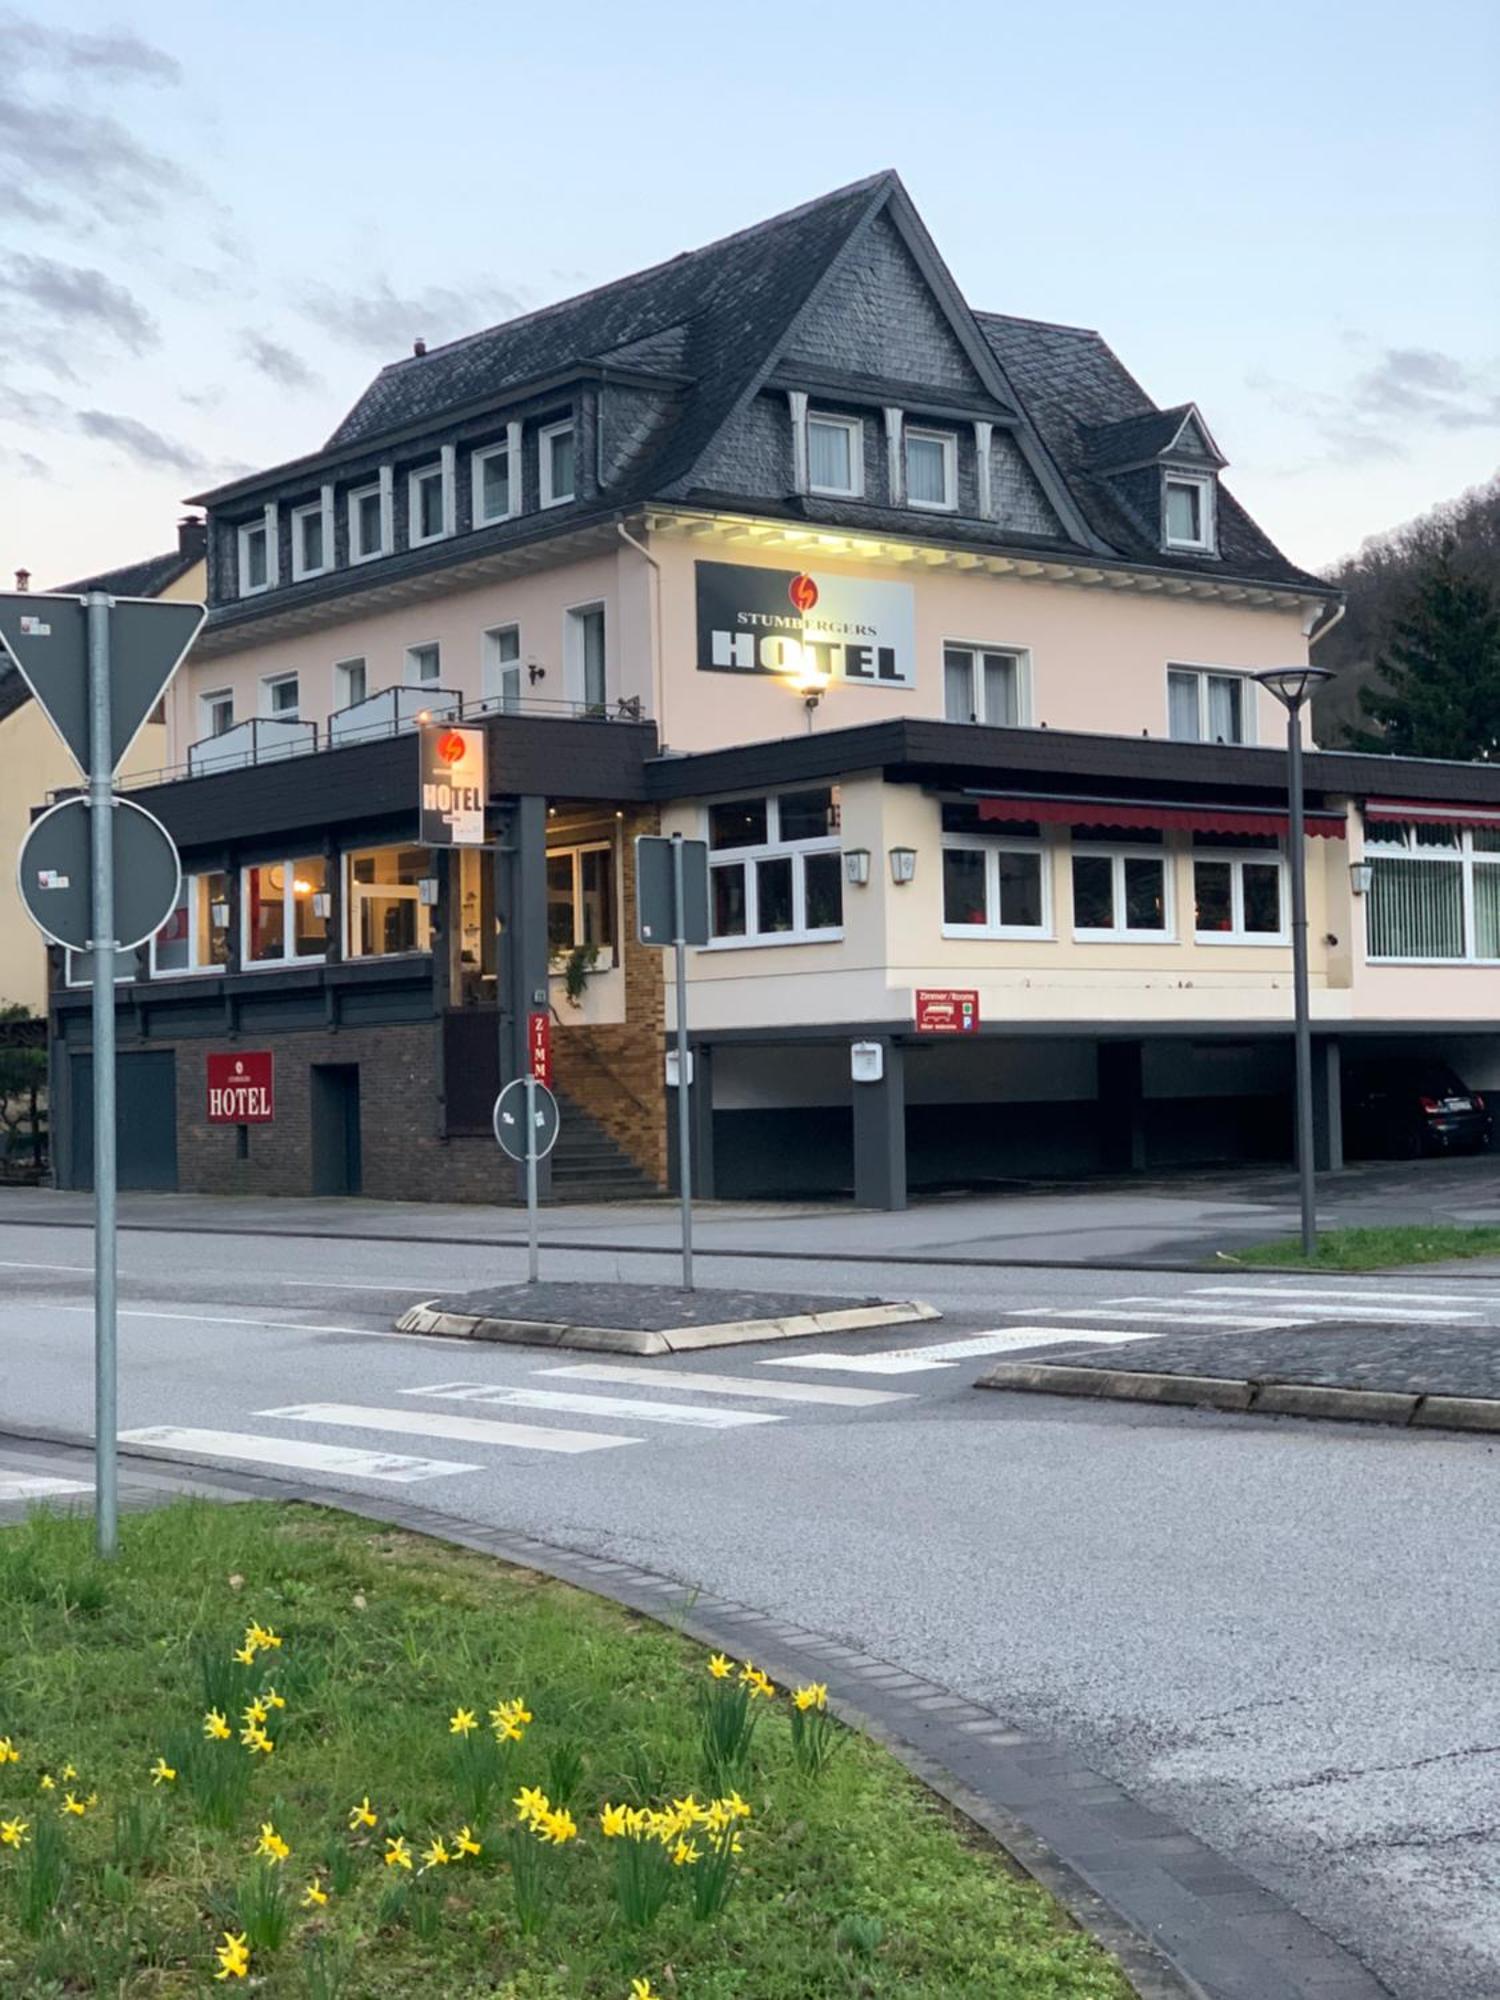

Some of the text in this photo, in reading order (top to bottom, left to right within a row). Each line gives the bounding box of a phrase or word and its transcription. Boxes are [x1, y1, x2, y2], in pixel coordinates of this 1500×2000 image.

[737, 612, 877, 636] STUMBERGERS
[711, 630, 906, 681] HOTEL
[423, 783, 482, 811] HOTEL
[209, 1087, 271, 1116] HOTEL
